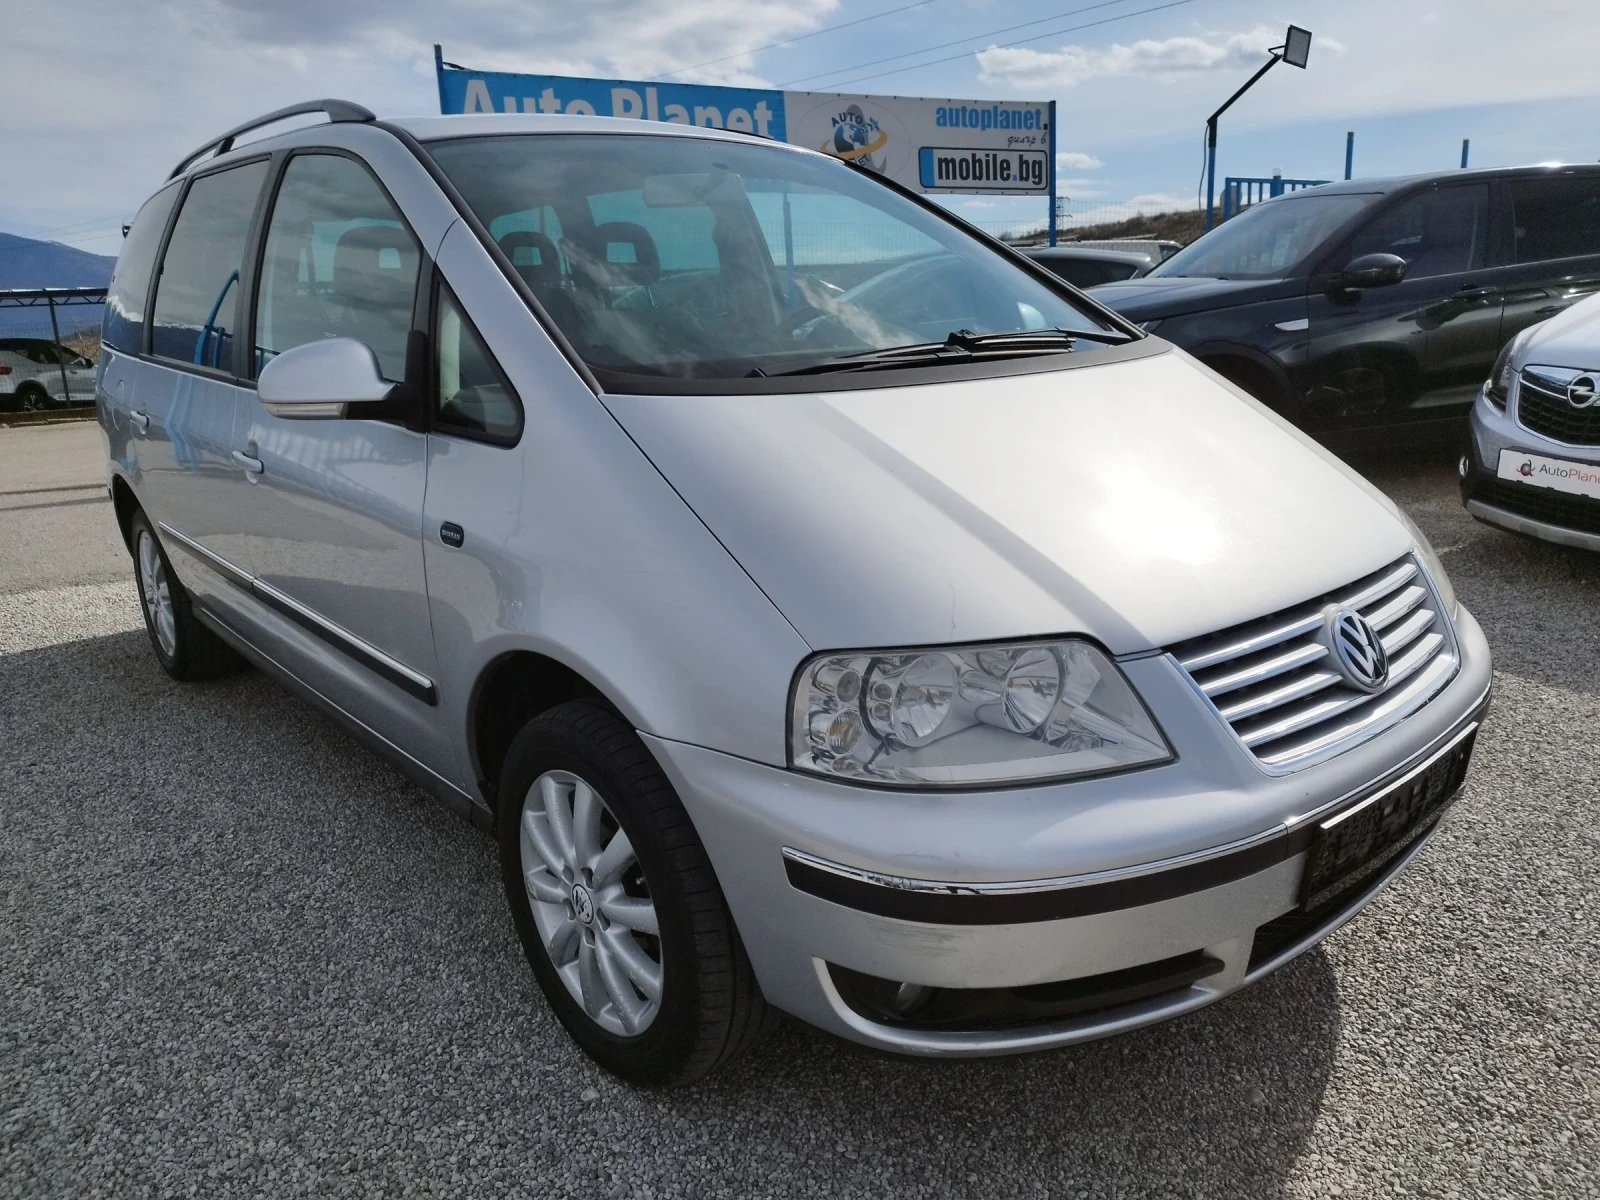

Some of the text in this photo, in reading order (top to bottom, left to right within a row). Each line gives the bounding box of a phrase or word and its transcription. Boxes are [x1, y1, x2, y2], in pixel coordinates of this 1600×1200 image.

[464, 80, 773, 138] Auto Planet
[831, 112, 863, 127] AUTO
[937, 153, 1043, 185] mobile.bg
[1539, 464, 1600, 484] AutoPlan
